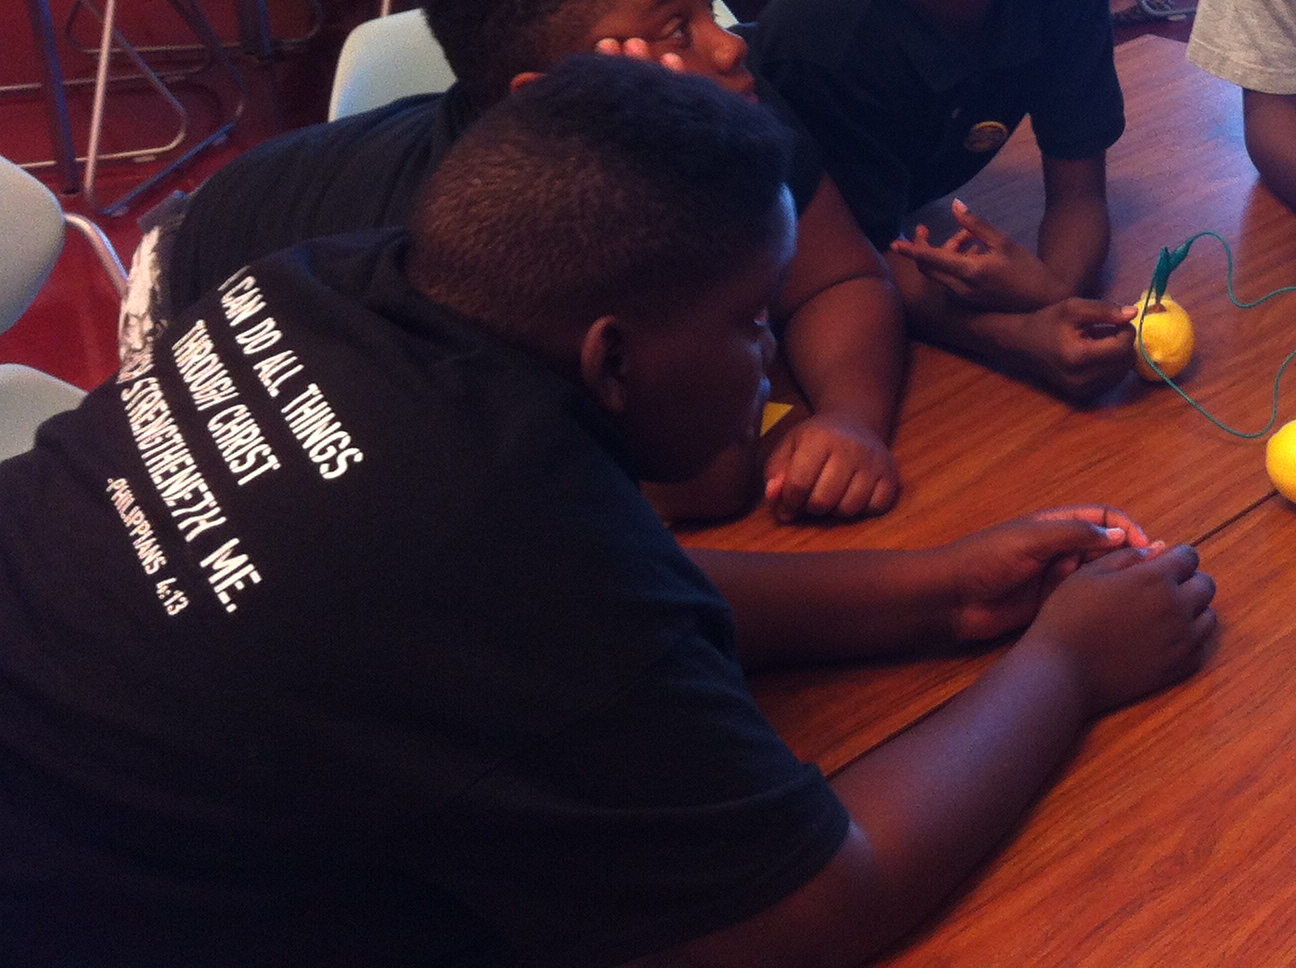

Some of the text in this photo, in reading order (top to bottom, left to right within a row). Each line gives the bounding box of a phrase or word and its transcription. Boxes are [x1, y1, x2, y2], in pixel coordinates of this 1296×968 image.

[220, 275, 266, 326] CAN
[235, 317, 282, 355] DO
[253, 349, 304, 398] ALL
[172, 319, 281, 486] THROUGH CHRIST
[281, 383, 364, 479] THINGS
[121, 377, 226, 543] STRENGTHENETH
[200, 538, 262, 613] ME.
[156, 577, 190, 616] 4:13
